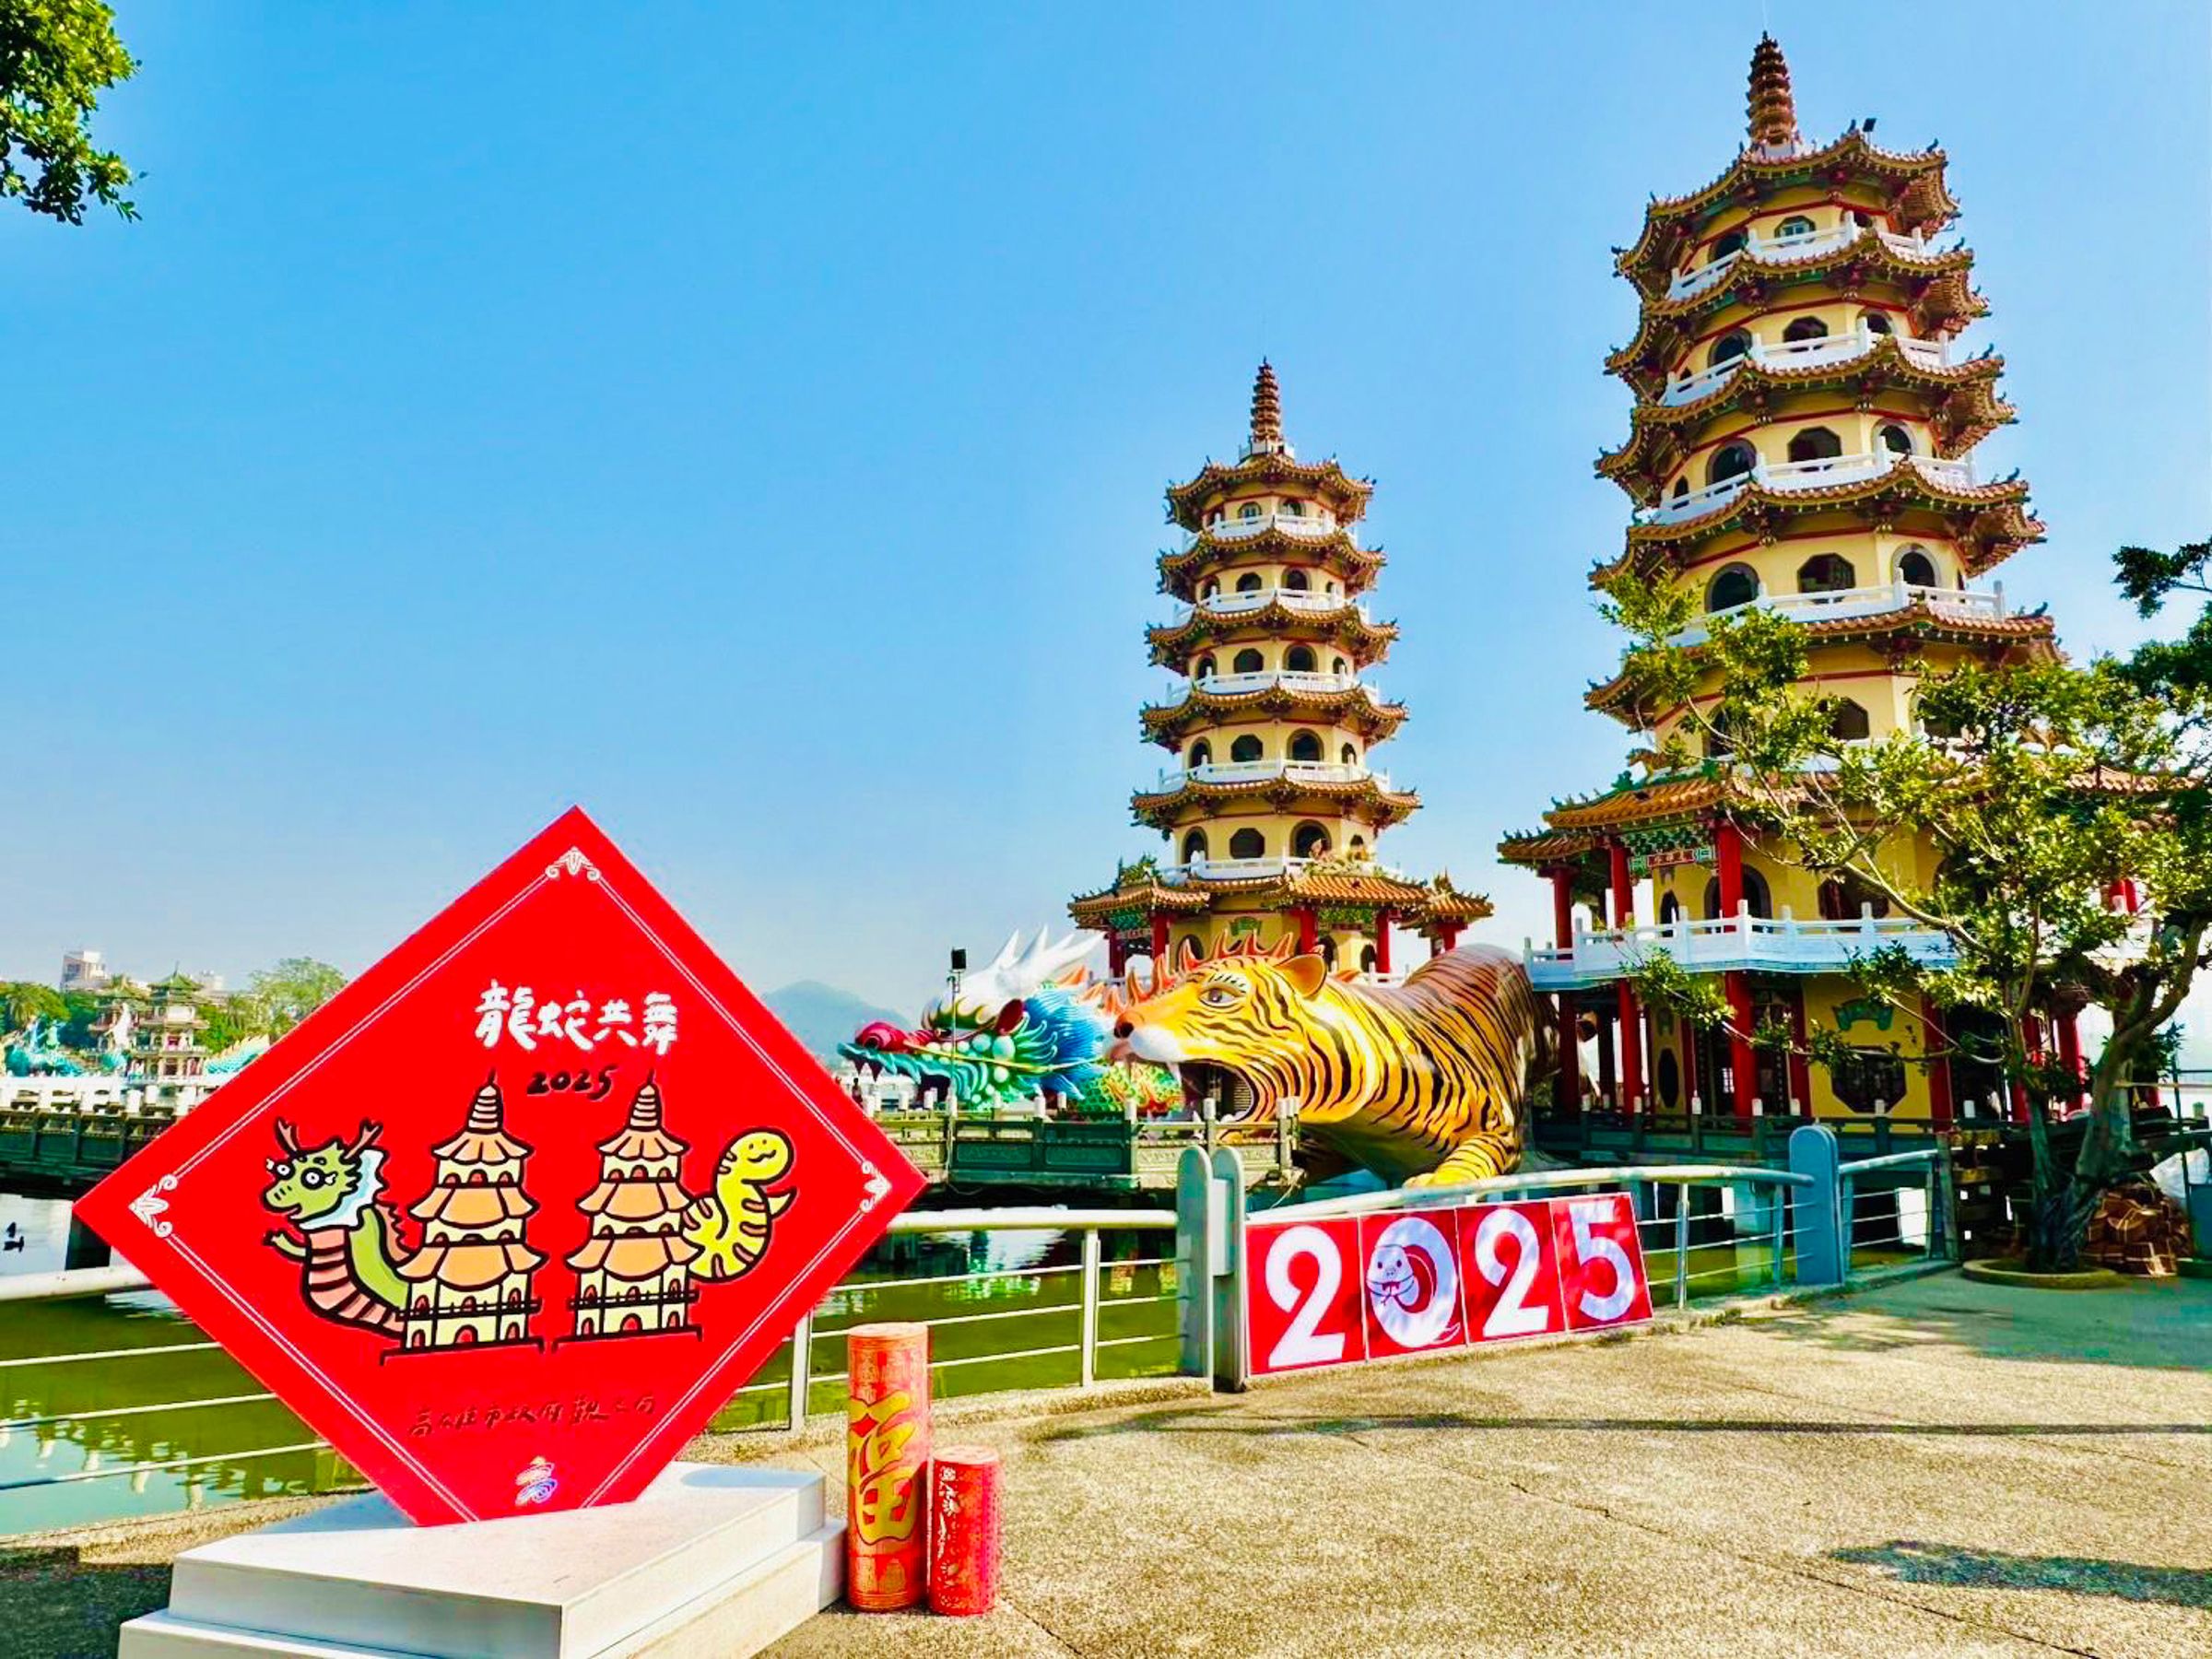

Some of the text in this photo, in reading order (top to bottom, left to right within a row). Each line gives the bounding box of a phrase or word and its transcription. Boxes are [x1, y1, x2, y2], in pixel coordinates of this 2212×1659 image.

[475, 979, 678, 1055] 龍蛇共舞
[526, 1063, 618, 1100] 2025
[1265, 1201, 1636, 1367] 2025
